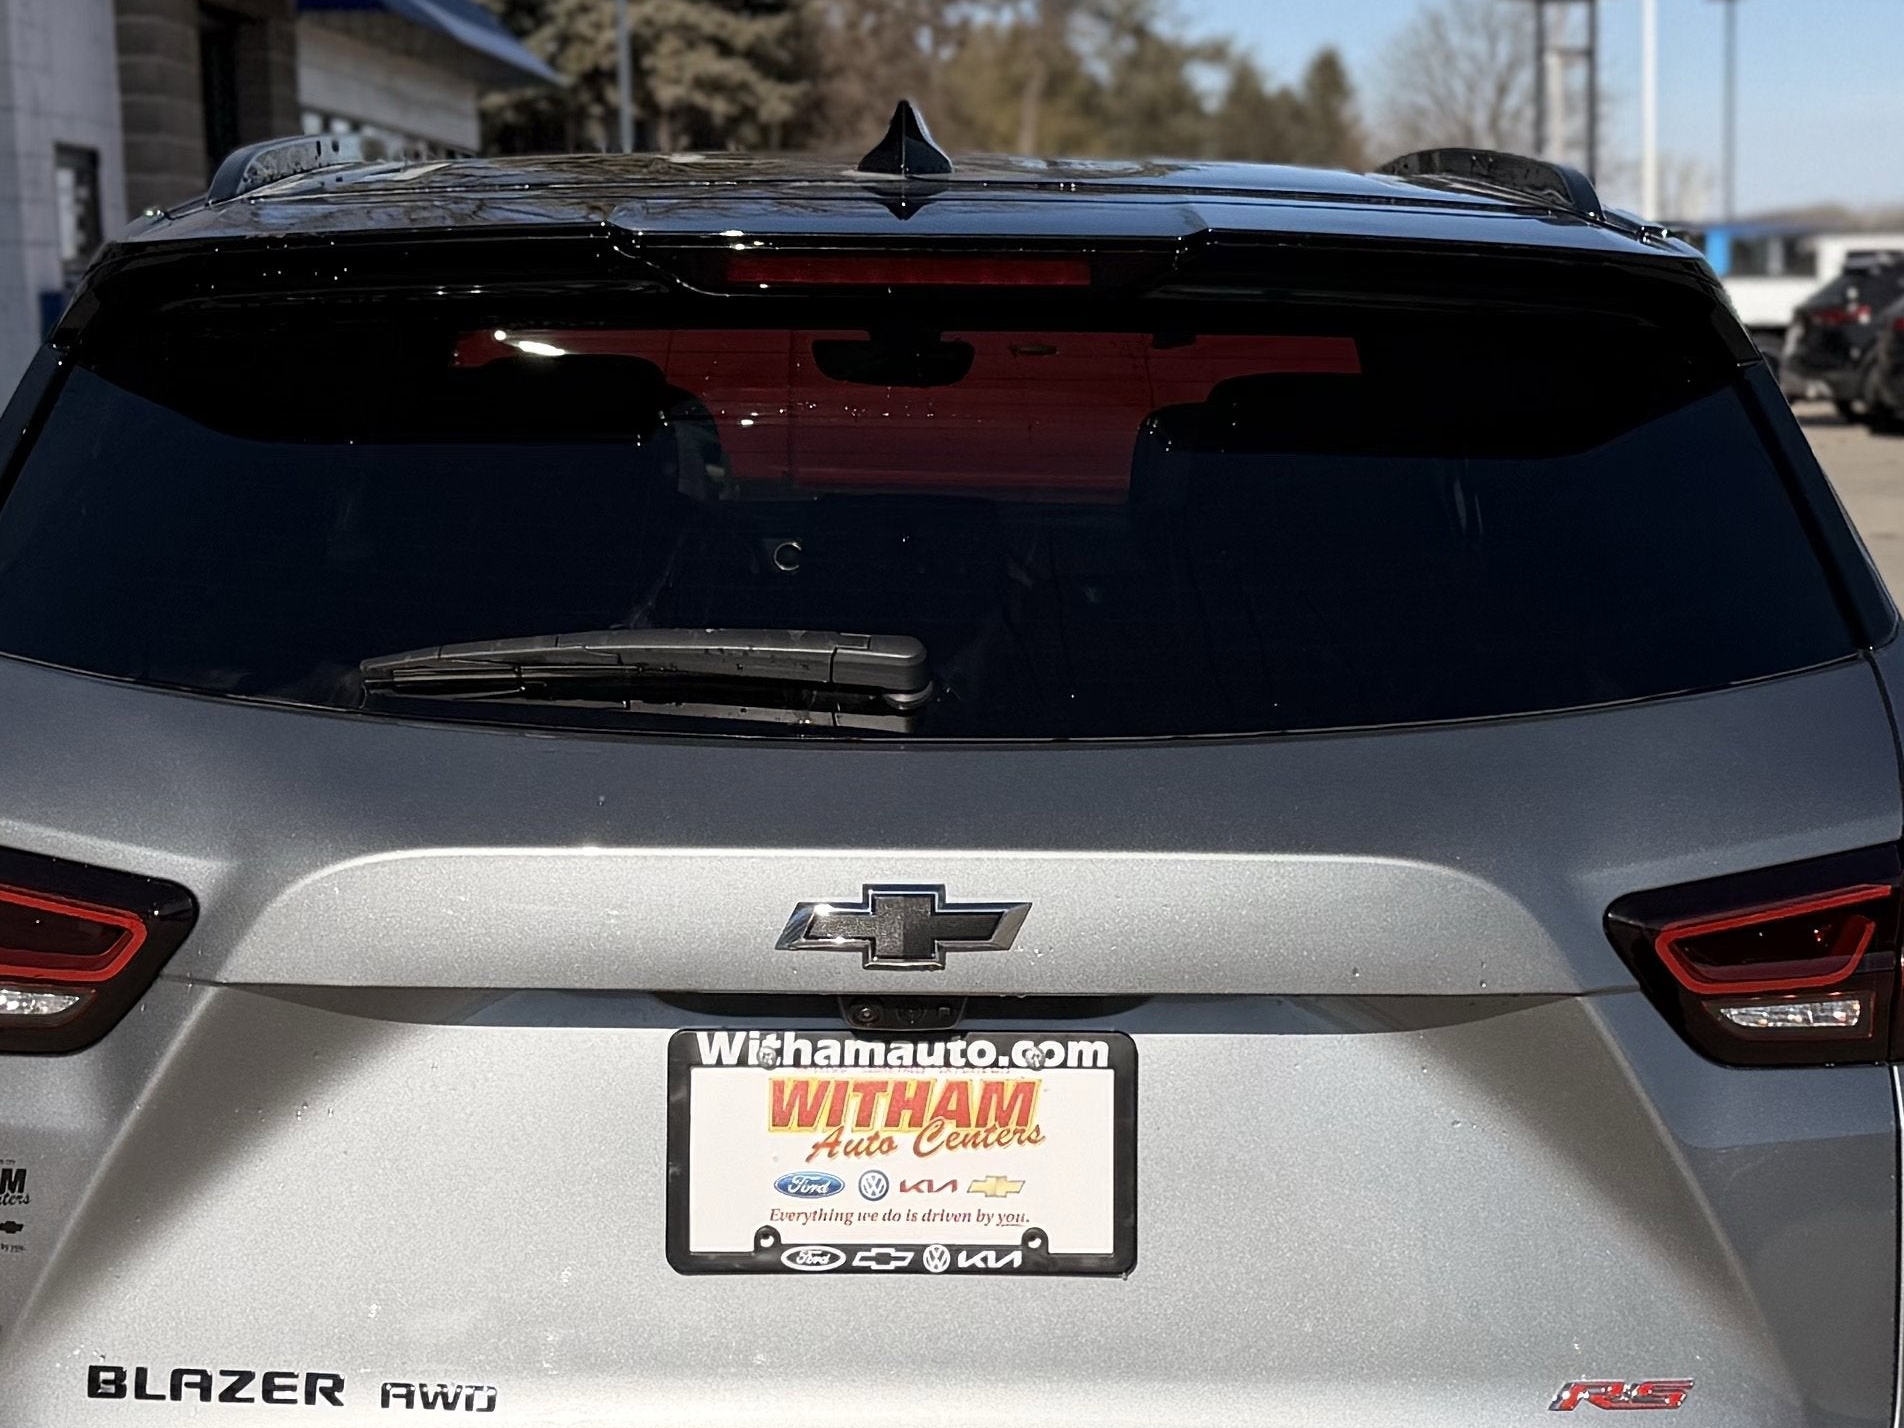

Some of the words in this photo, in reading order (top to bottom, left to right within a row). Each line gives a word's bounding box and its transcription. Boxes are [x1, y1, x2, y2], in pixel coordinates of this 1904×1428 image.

[696, 1031, 1109, 1068] Withamauto.com
[769, 1079, 1039, 1131] WITHAM
[805, 1125, 898, 1162] Auto
[912, 1119, 1046, 1158] Centers
[782, 1173, 838, 1197] Ford
[770, 1208, 854, 1225] Everything
[857, 1211, 878, 1222] we
[882, 1209, 901, 1222] do
[906, 1209, 918, 1222] is
[922, 1209, 971, 1223] driven
[977, 1209, 994, 1226] by
[997, 1212, 1030, 1227] you.
[87, 1365, 345, 1407] BLAZER
[380, 1381, 497, 1412] AWD
[1548, 1378, 1694, 1411] RS
